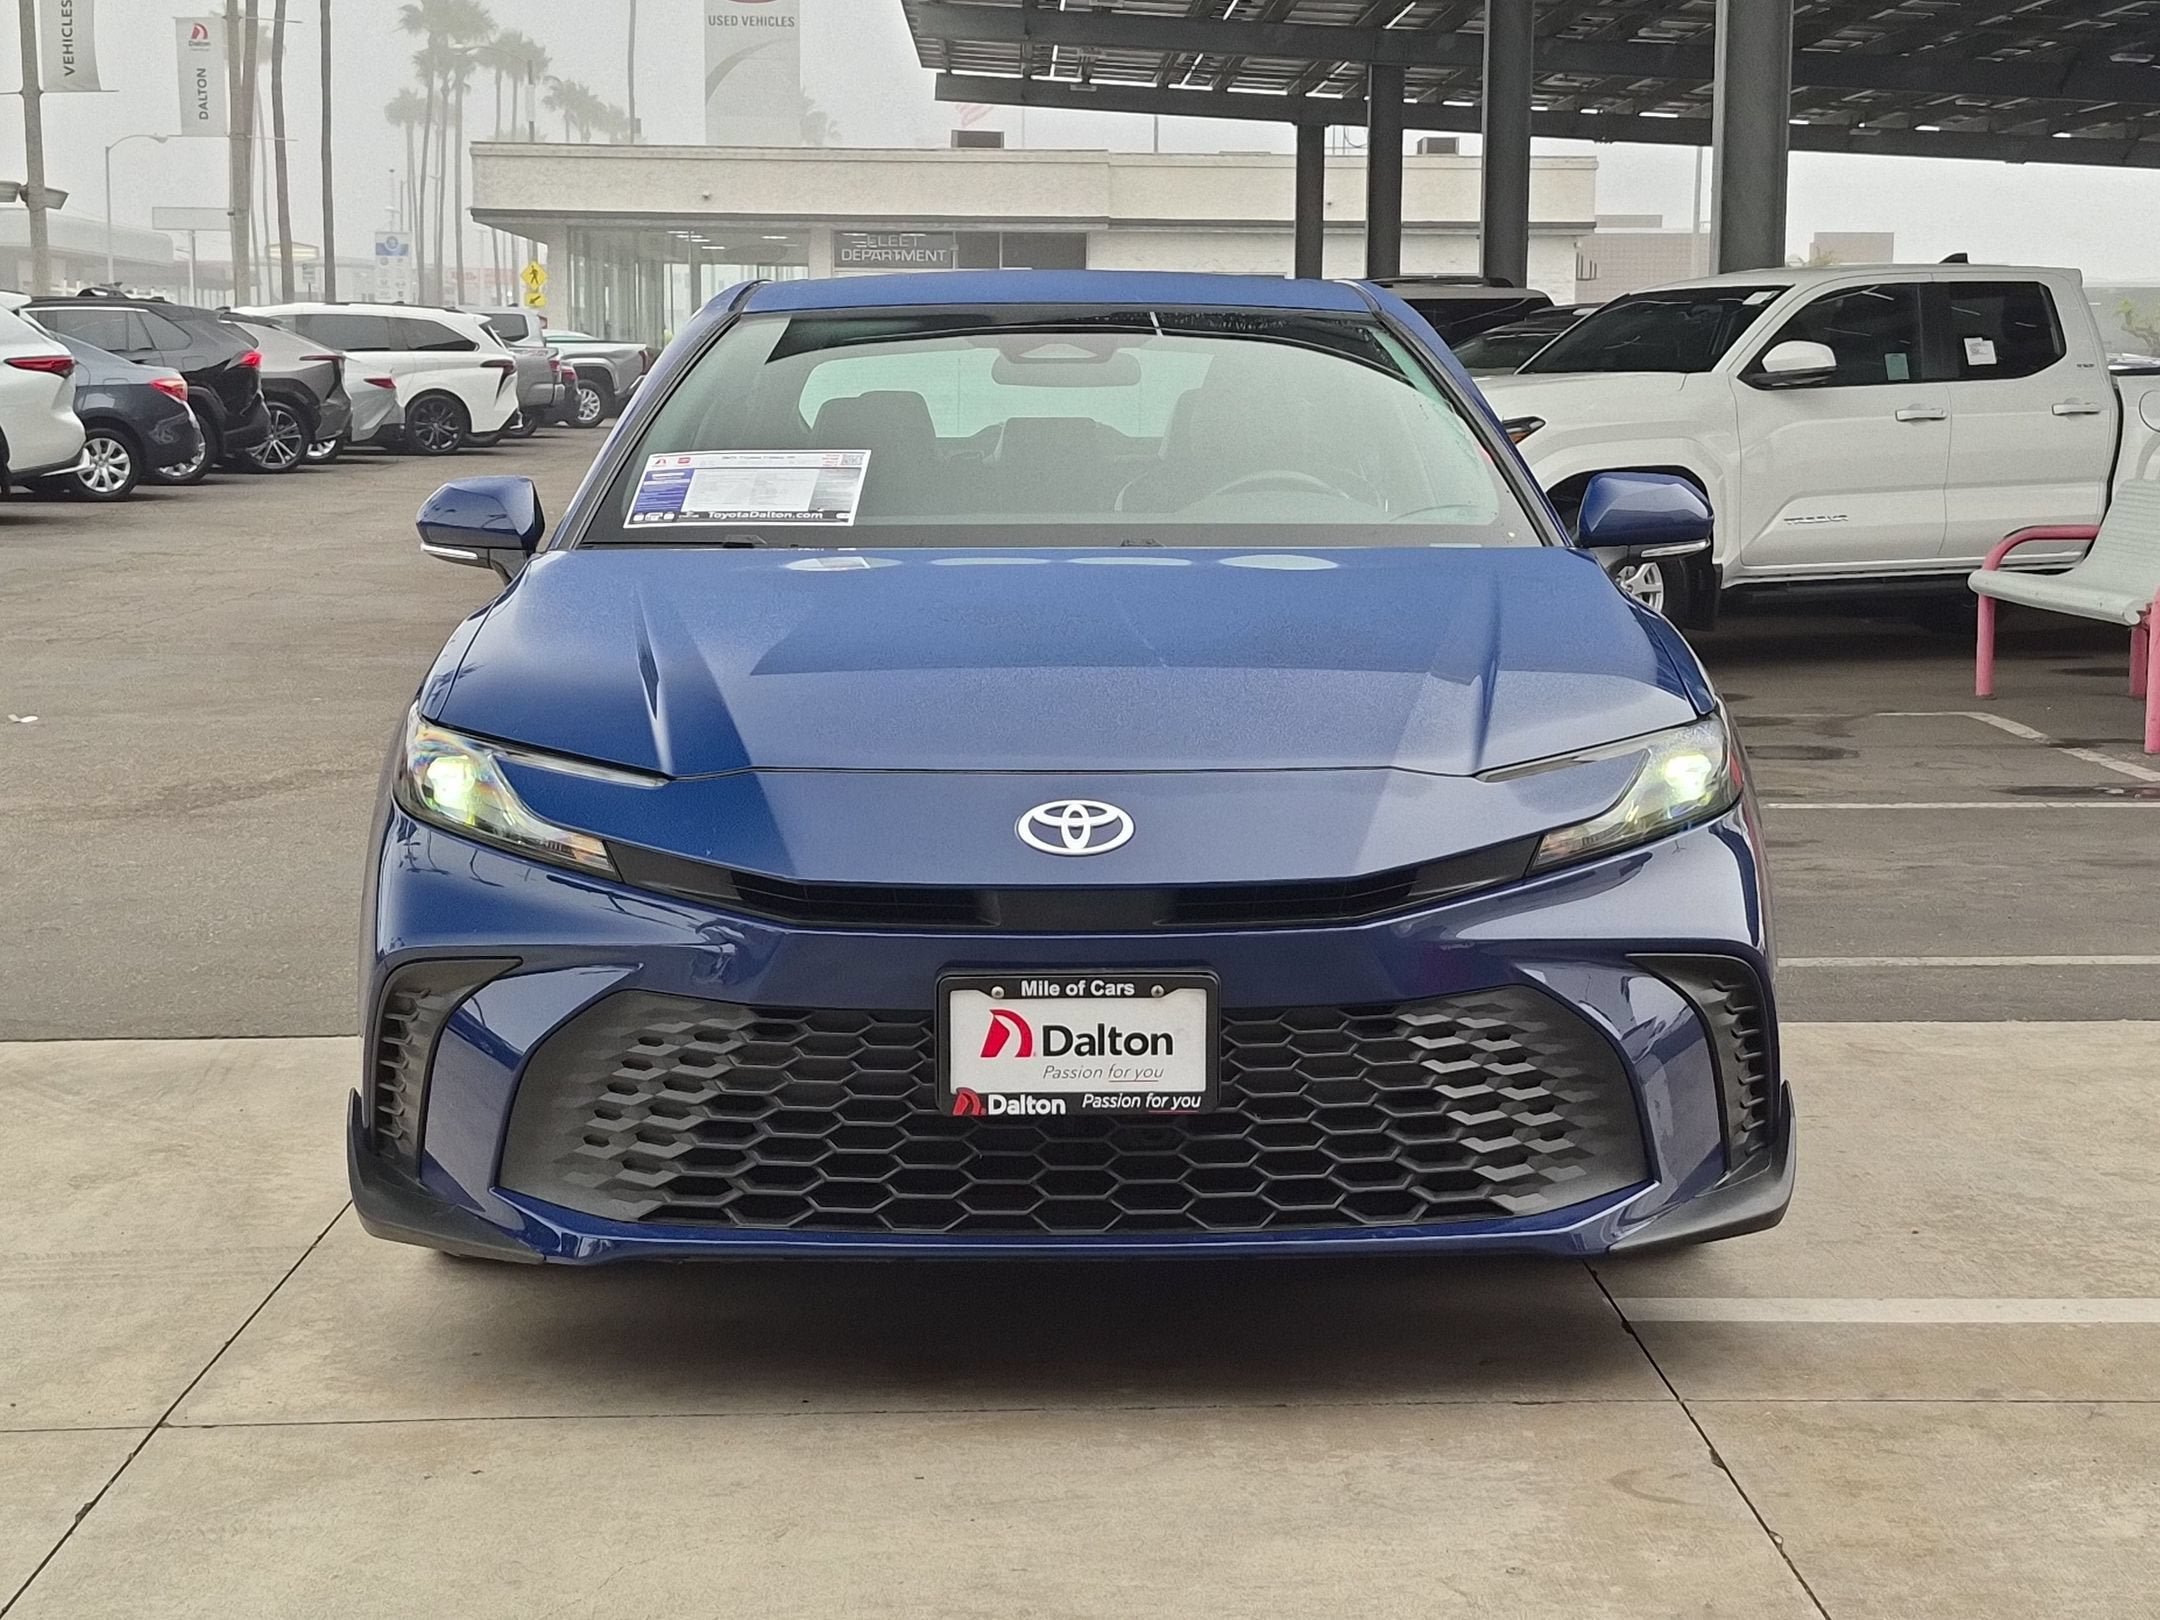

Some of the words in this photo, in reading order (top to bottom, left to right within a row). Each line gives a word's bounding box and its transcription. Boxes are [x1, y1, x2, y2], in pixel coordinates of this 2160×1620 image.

[708, 15, 738, 26] USED
[741, 15, 795, 27] VEHICLES
[61, 0, 76, 77] VEHICLES
[196, 68, 209, 120] DALTON
[841, 248, 947, 262] DEPARTMENT
[707, 510, 824, 521] ToyotaDalton.com
[1021, 980, 1060, 996] Mile
[1065, 980, 1087, 996] of
[1090, 980, 1136, 996] Cars
[1042, 1023, 1174, 1057] Dalton
[1042, 1065, 1103, 1080] Passion
[1108, 1064, 1131, 1081] for
[1135, 1067, 1165, 1081] you
[988, 1094, 1067, 1116] Dalton
[1082, 1093, 1142, 1109] Passion
[1145, 1093, 1170, 1110] for
[1170, 1095, 1202, 1112] you
